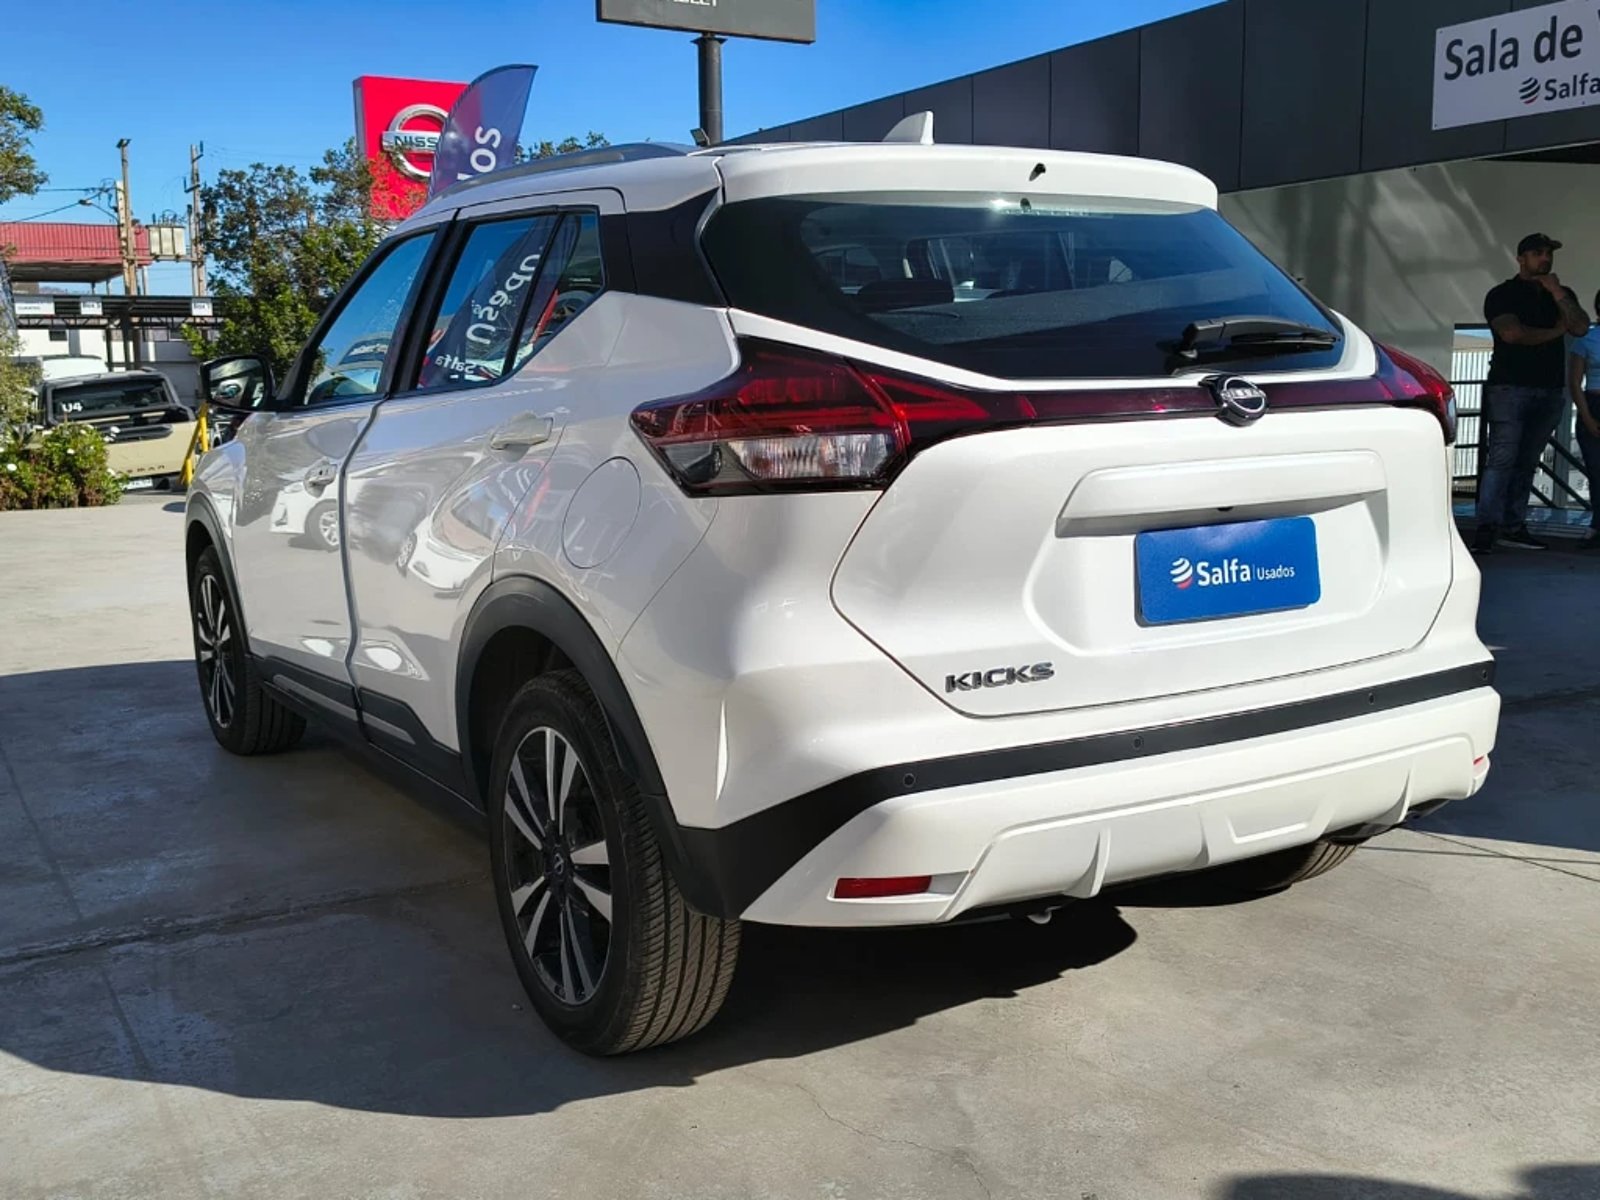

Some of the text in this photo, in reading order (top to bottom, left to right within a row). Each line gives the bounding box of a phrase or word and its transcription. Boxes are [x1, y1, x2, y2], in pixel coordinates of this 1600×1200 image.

[1444, 15, 1583, 81] Sala de
[1544, 73, 1600, 101] Salfa
[1197, 559, 1295, 587] Salfa Usados
[945, 662, 1055, 693] KICKS
